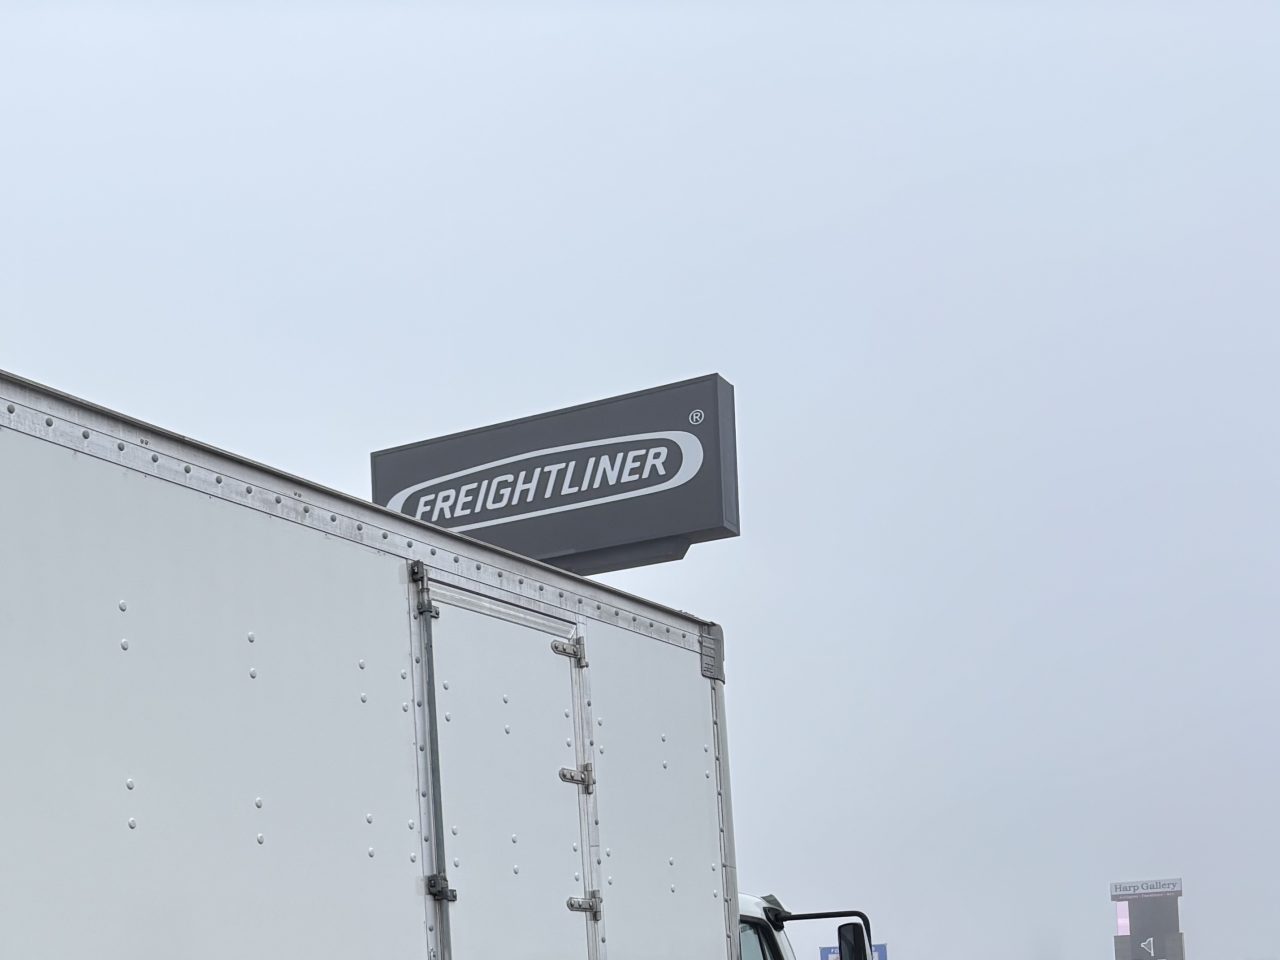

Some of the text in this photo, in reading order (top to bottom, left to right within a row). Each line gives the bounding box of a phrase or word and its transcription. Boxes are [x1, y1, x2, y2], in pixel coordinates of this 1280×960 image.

[415, 446, 668, 521] FREIGHTLINER
[1114, 881, 1177, 892] Harp Gallery
